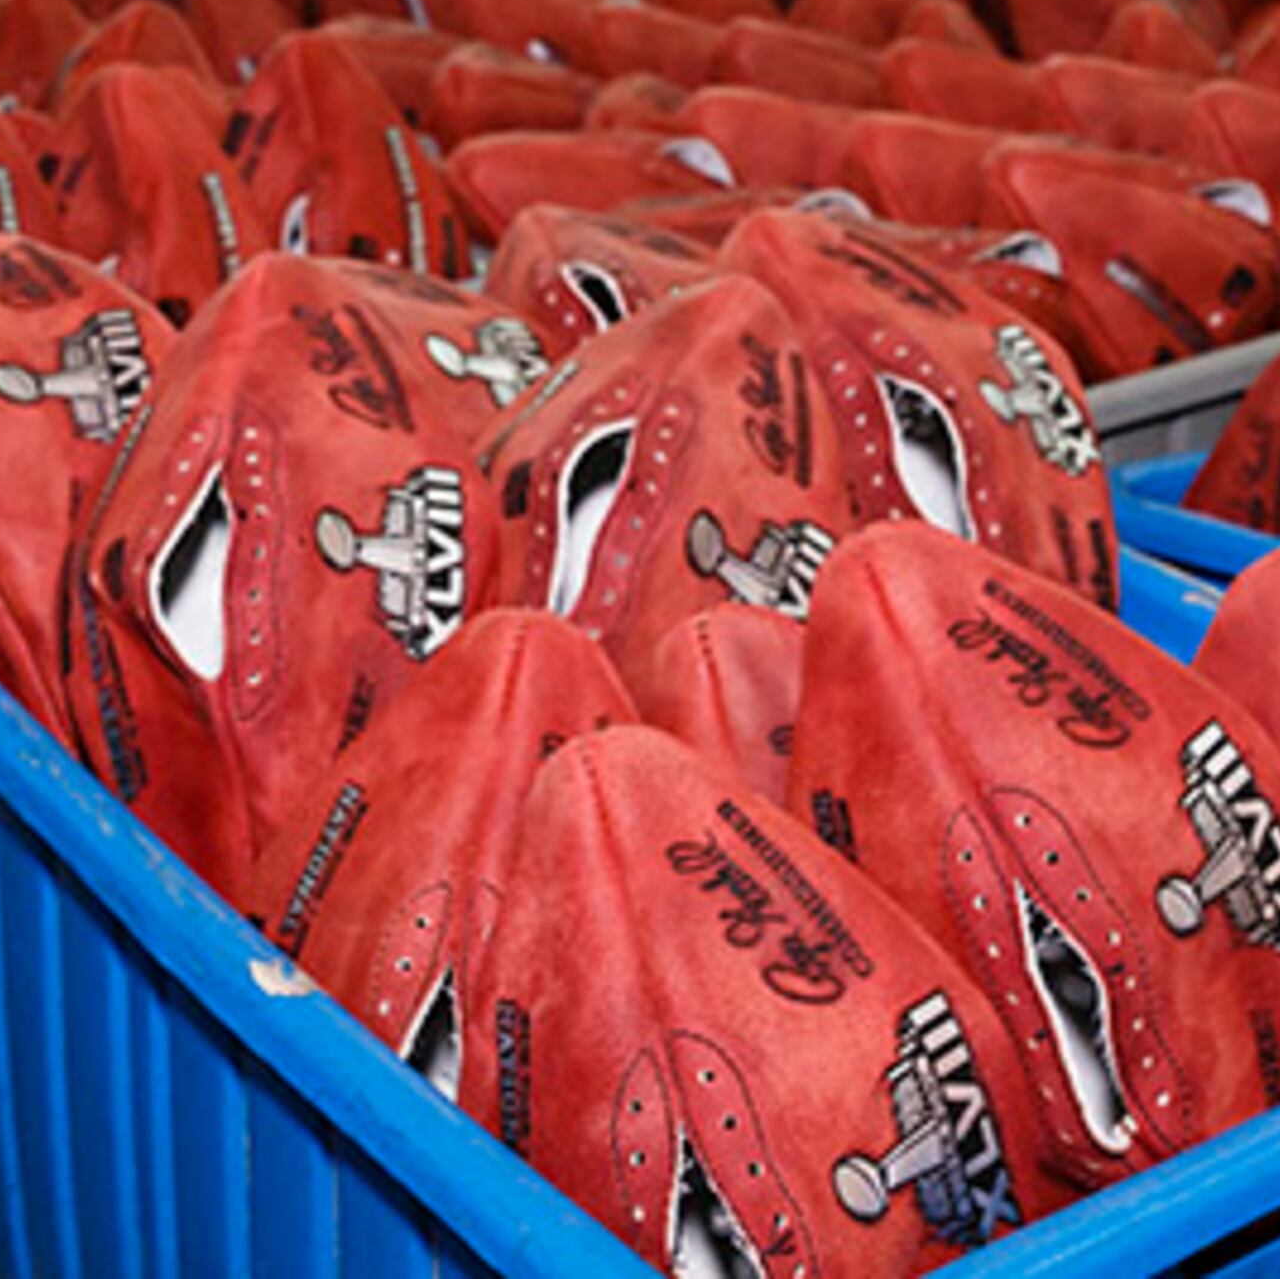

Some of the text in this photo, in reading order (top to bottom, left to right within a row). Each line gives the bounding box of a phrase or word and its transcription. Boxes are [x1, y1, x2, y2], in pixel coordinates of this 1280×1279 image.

[97, 309, 150, 411] LVIII
[421, 467, 464, 657] XLVIII
[279, 781, 365, 934] NATIONAL
[717, 799, 874, 979] COMMISSIONER
[905, 989, 1022, 1240] XLVIII
